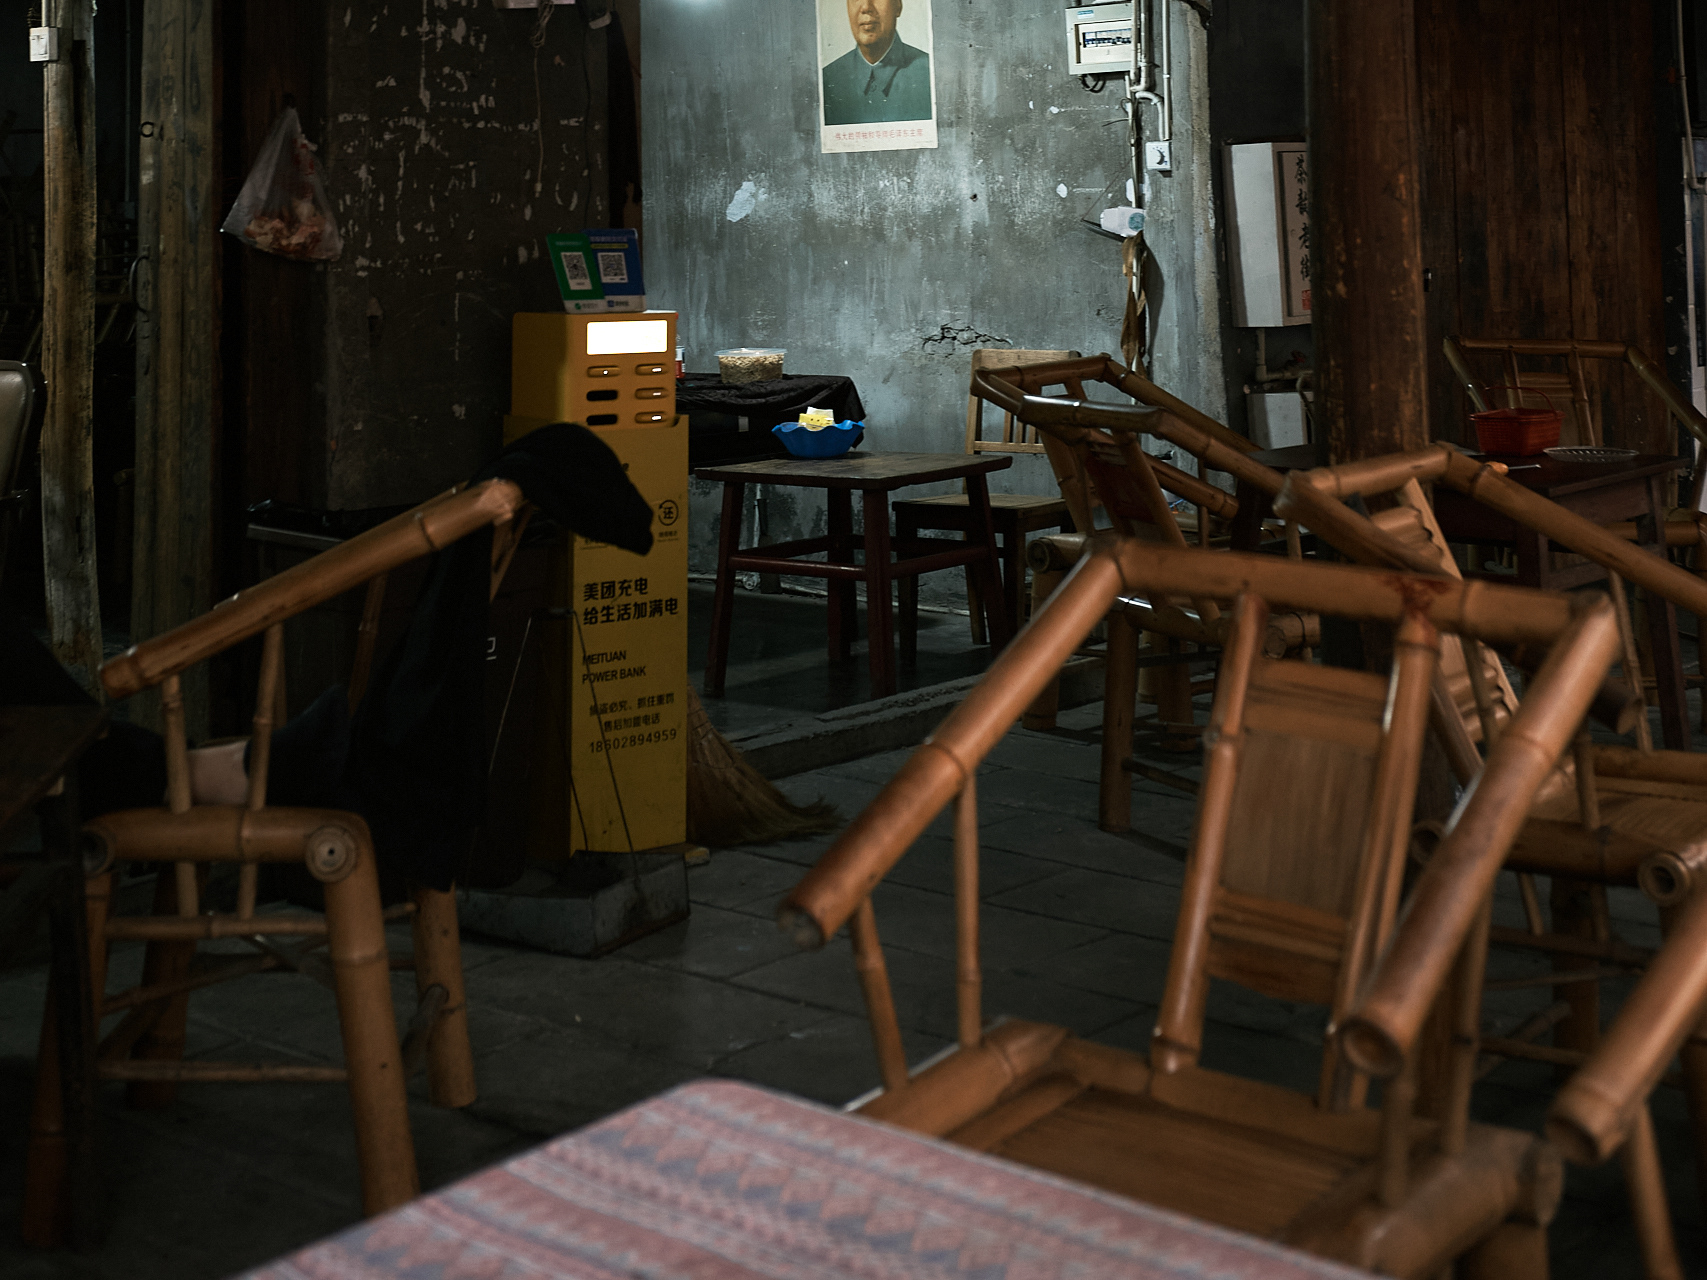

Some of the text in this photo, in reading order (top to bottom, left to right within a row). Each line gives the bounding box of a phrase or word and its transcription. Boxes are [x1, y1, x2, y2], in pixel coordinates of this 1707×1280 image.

[663, 507, 674, 519] 还
[584, 577, 648, 601] 美团充电
[583, 598, 679, 625] 给生活加满电
[583, 650, 627, 666] MEITUAN
[582, 665, 647, 685] POWER BANK
[589, 728, 677, 754] 18602894959
